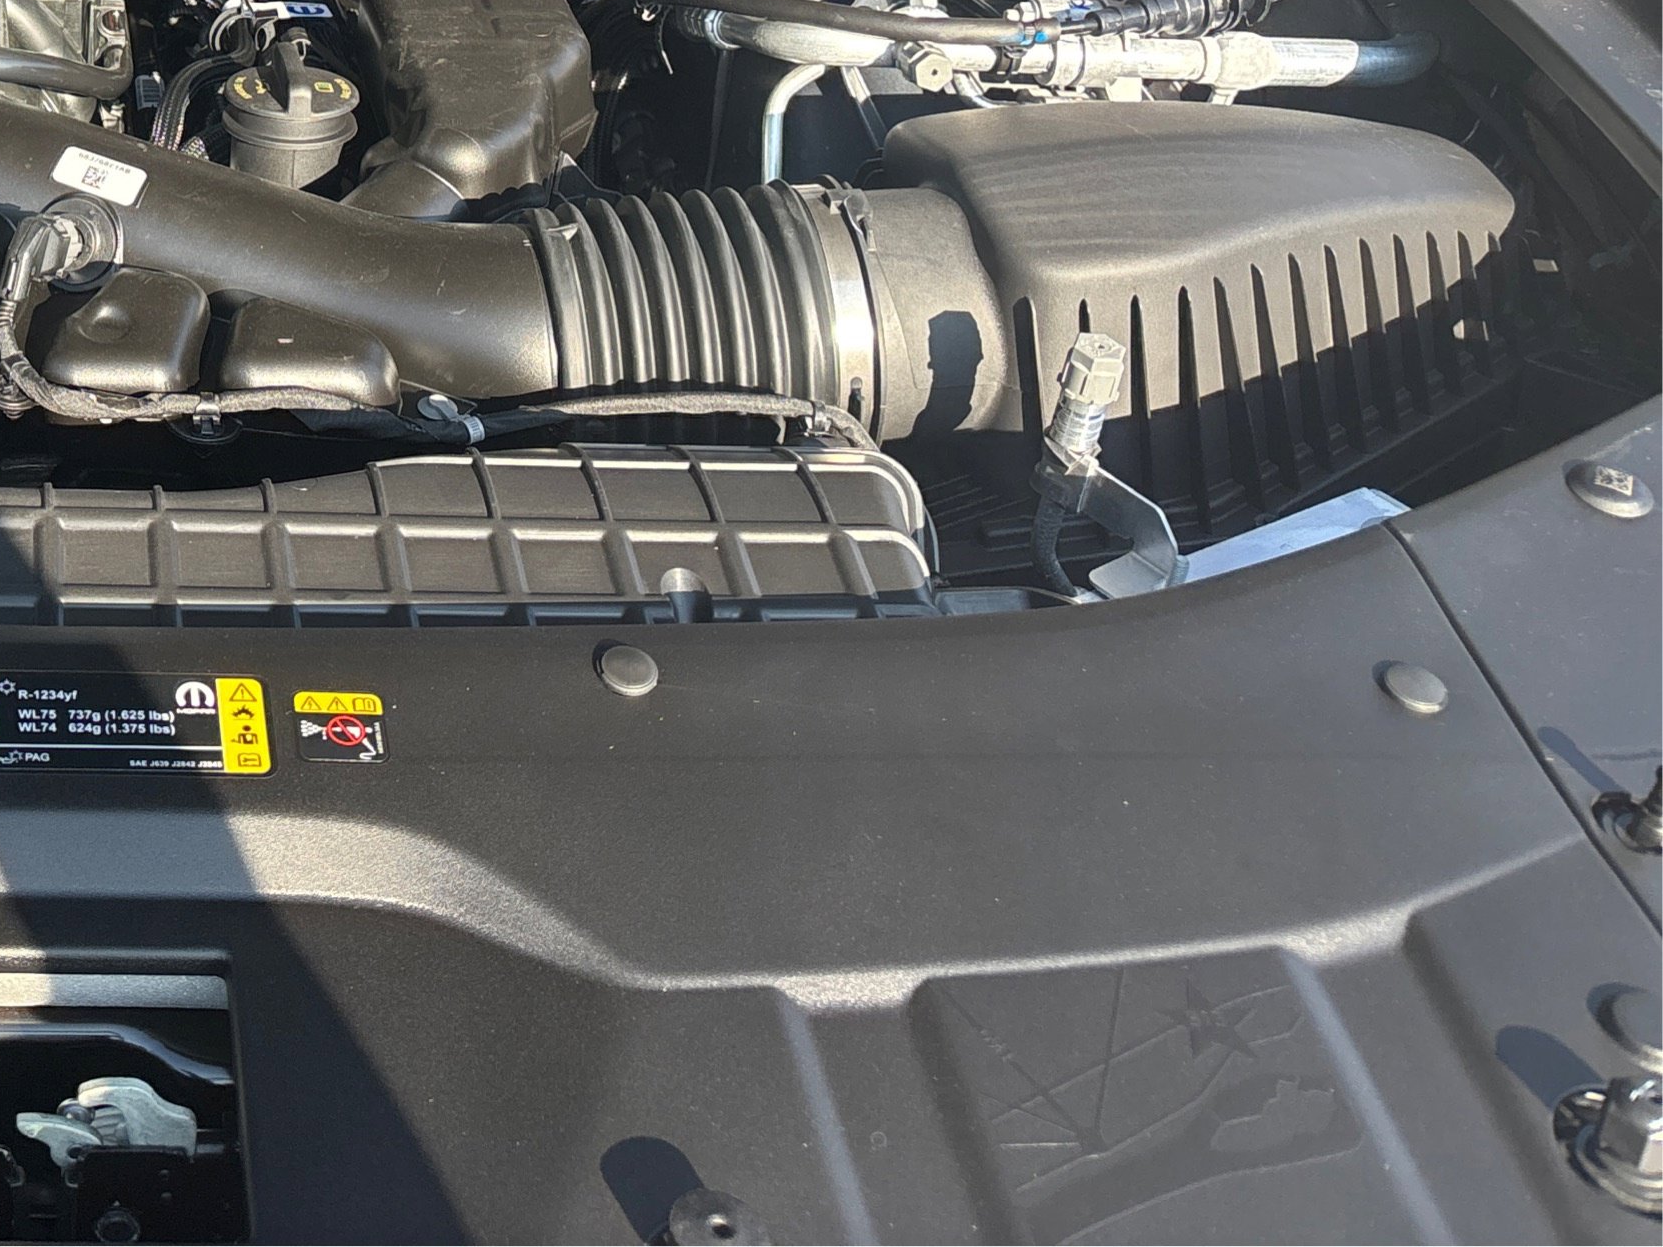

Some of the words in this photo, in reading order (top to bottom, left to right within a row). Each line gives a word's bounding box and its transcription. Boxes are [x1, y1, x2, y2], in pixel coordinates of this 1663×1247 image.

[18, 689, 78, 702] R-1234yf
[18, 709, 57, 720] WL75
[68, 709, 101, 722] 737g
[104, 709, 146, 722] (1.625
[148, 710, 175, 723] lbs)
[18, 722, 57, 732] WL74
[68, 722, 102, 735] 624g
[105, 722, 146, 735] (1.375
[149, 723, 176, 736] lbs)
[25, 752, 50, 762] PAG
